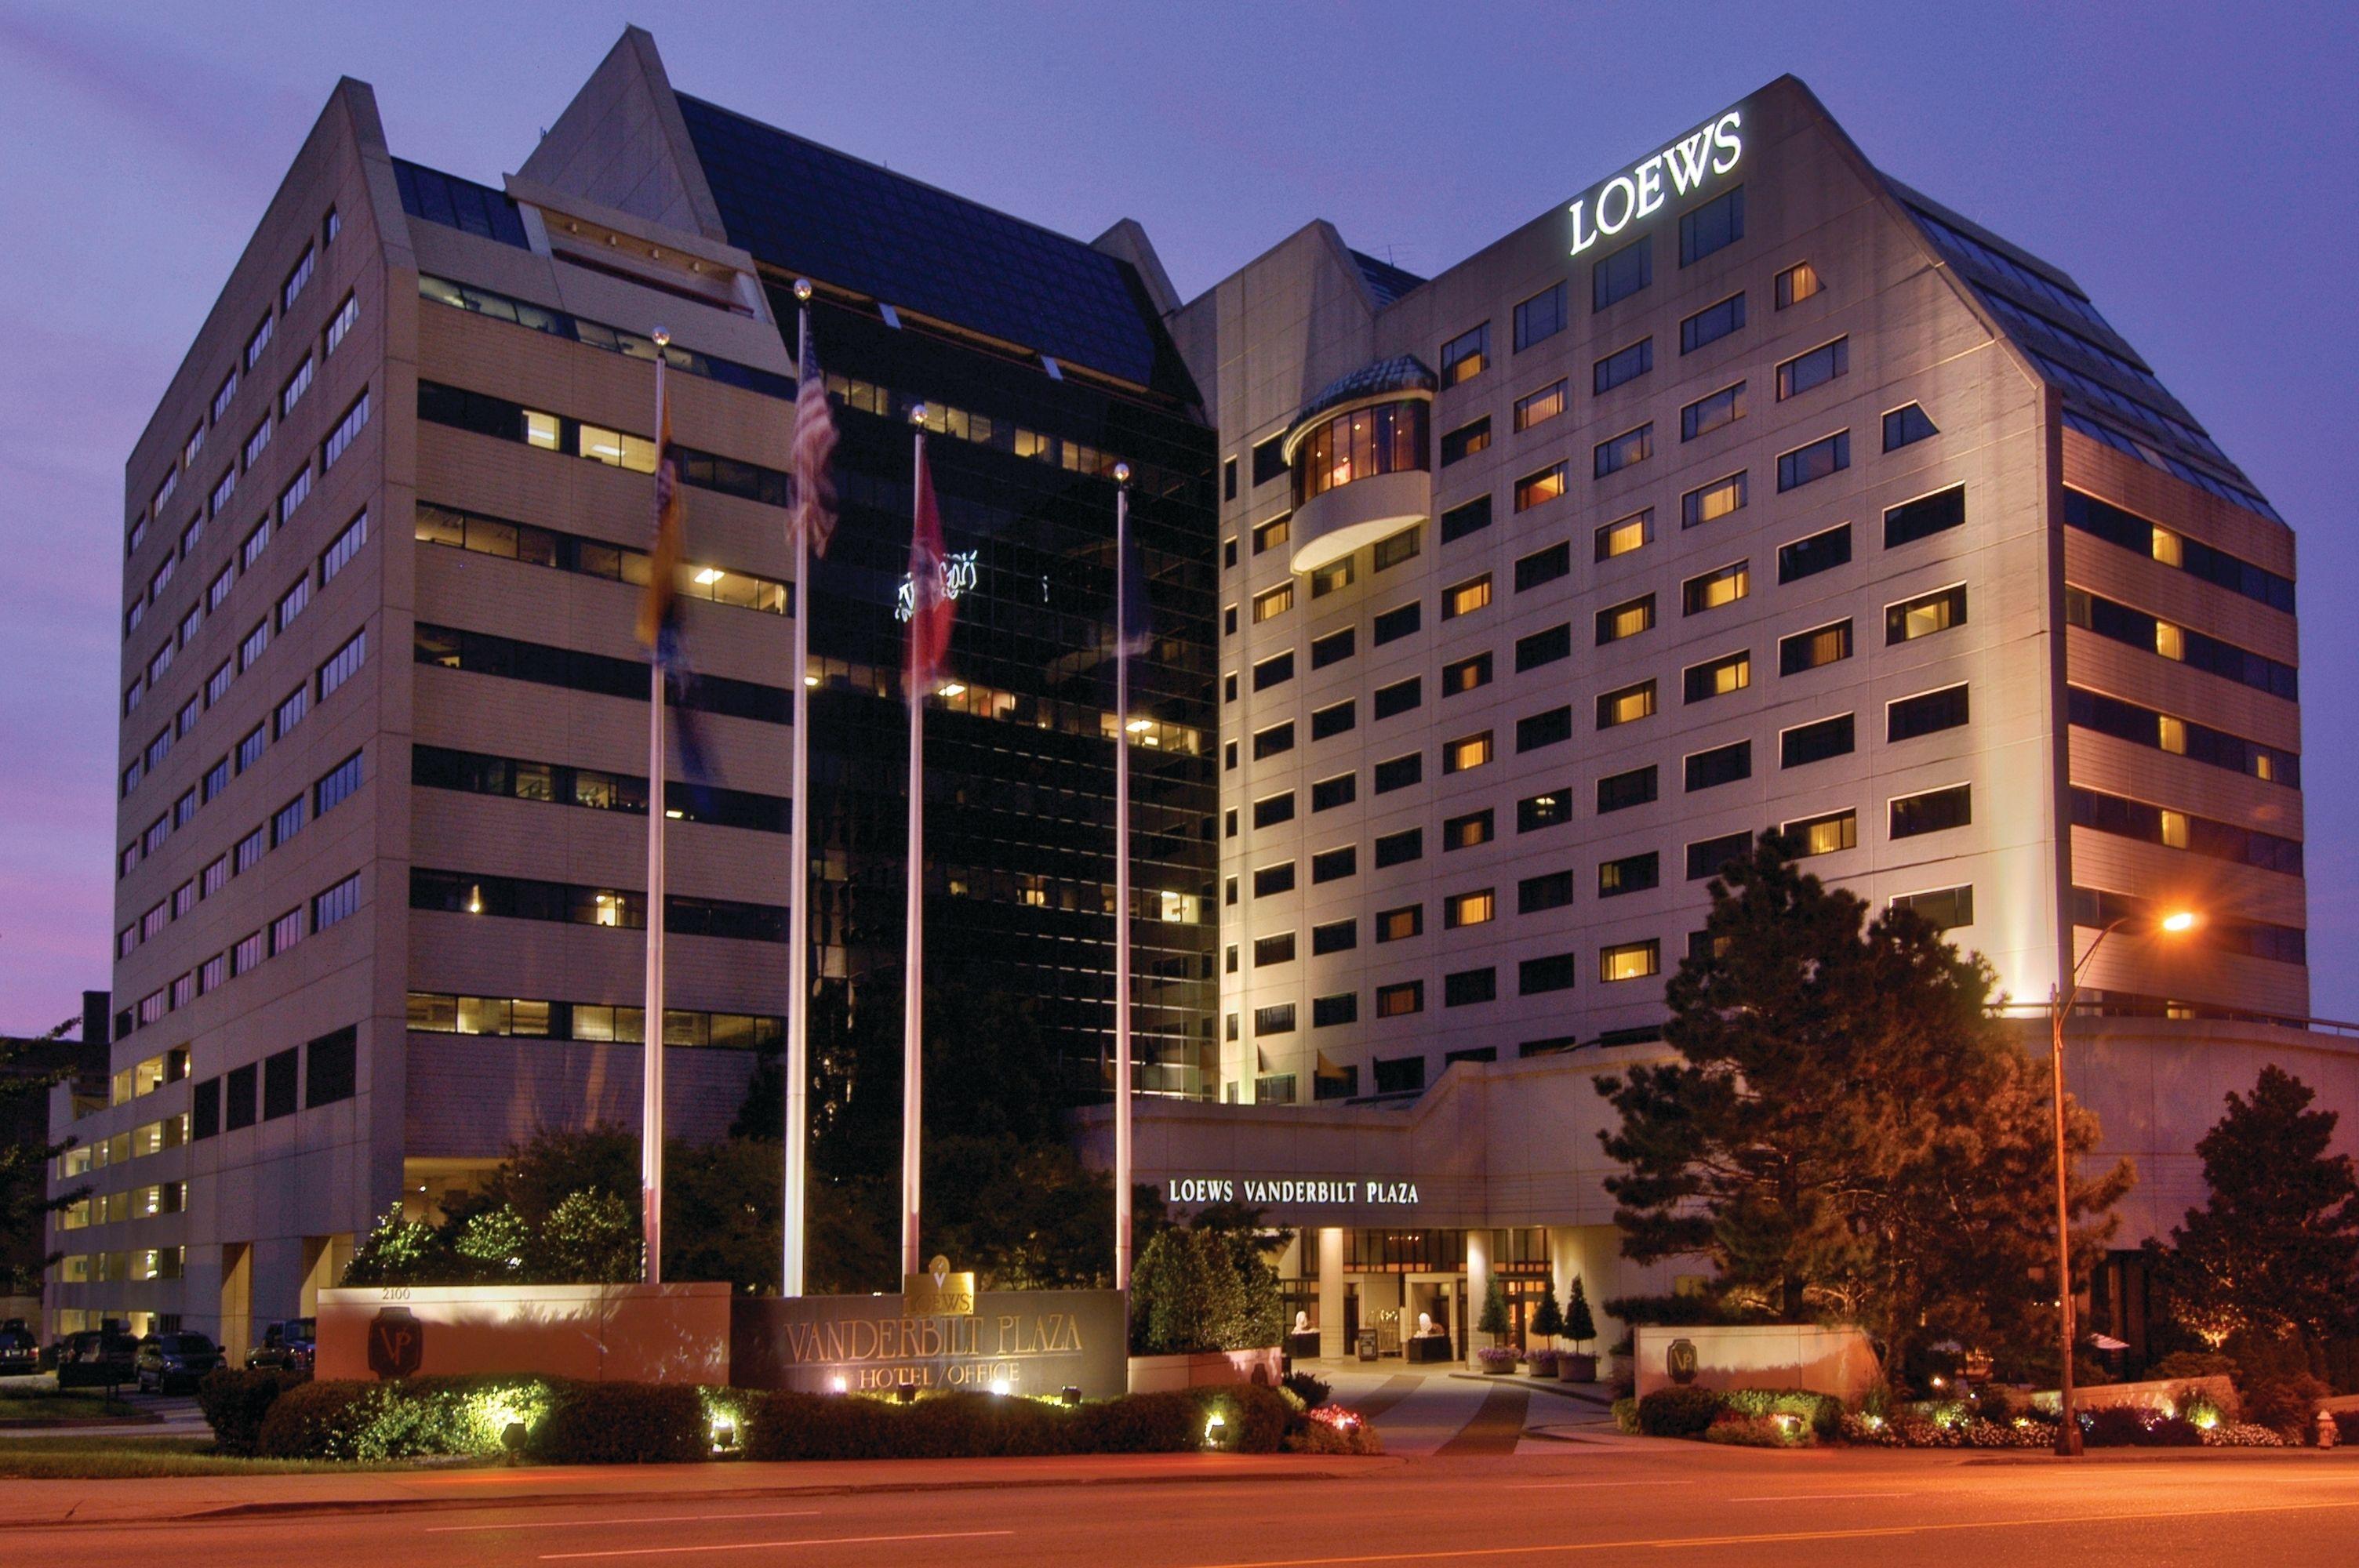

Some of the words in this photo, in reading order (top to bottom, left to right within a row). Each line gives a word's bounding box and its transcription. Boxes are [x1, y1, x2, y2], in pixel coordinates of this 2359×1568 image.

[1568, 111, 1742, 256] LOEWS
[1168, 1179, 1234, 1202] LOEWS
[1244, 1181, 1357, 1203] VANDERBILT
[1367, 1182, 1419, 1203] PLAZA
[382, 1287, 410, 1300] 2100
[907, 1293, 970, 1312] LOEWS
[784, 1316, 983, 1363] VANDERBILT
[997, 1315, 1082, 1354] PLAZA
